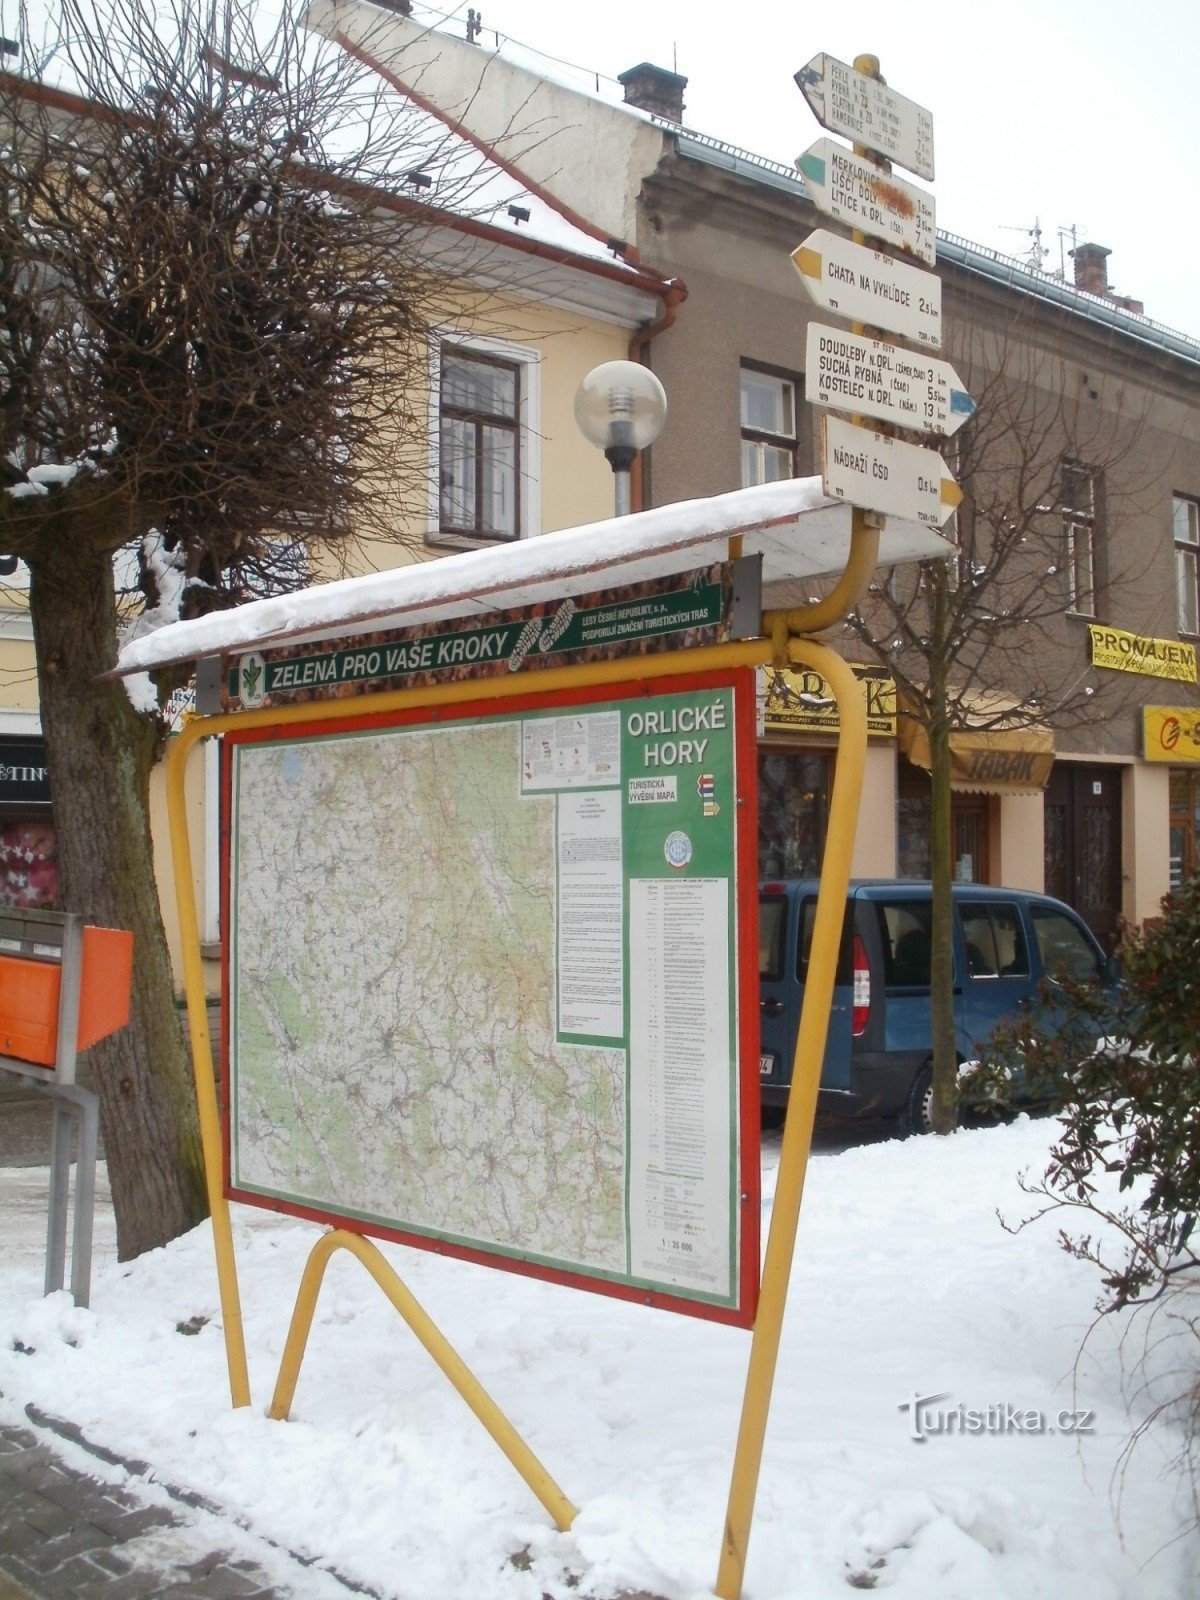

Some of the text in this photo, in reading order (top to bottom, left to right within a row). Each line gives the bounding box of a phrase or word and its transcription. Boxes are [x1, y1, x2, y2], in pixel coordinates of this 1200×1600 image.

[832, 153, 881, 188] MERKLOVICE
[832, 171, 854, 193] LIŠČÍ
[831, 189, 858, 213] LITICE
[828, 262, 855, 286] CHATA
[860, 275, 870, 292] NA
[873, 283, 910, 308] VYHLÍDCE
[820, 337, 866, 363] DOUDLEBY
[928, 370, 934, 383] 3
[937, 373, 946, 386] km
[820, 356, 850, 376] SUCHÁ
[855, 366, 882, 385] RYBNÁ
[819, 373, 864, 399] KOSTELEC
[924, 402, 933, 417] 13
[937, 410, 946, 420] km
[834, 446, 868, 474] NÁDRAŽÍ
[873, 458, 888, 480] ČSD
[582, 615, 597, 626] LESY
[598, 608, 617, 623] ČESKÉ
[618, 619, 644, 634] ZNAČENÍ
[645, 611, 690, 629] TURISTICKÝCH
[691, 608, 708, 620] TRAS
[272, 631, 508, 688] ZELENÁ PRO VAŠE KROKY
[627, 698, 726, 737] ORLICKÉ
[645, 739, 708, 767] HORY
[629, 779, 665, 790] TURISTICKÁ
[629, 787, 675, 801] VÝVĚSNÍ MAPA
